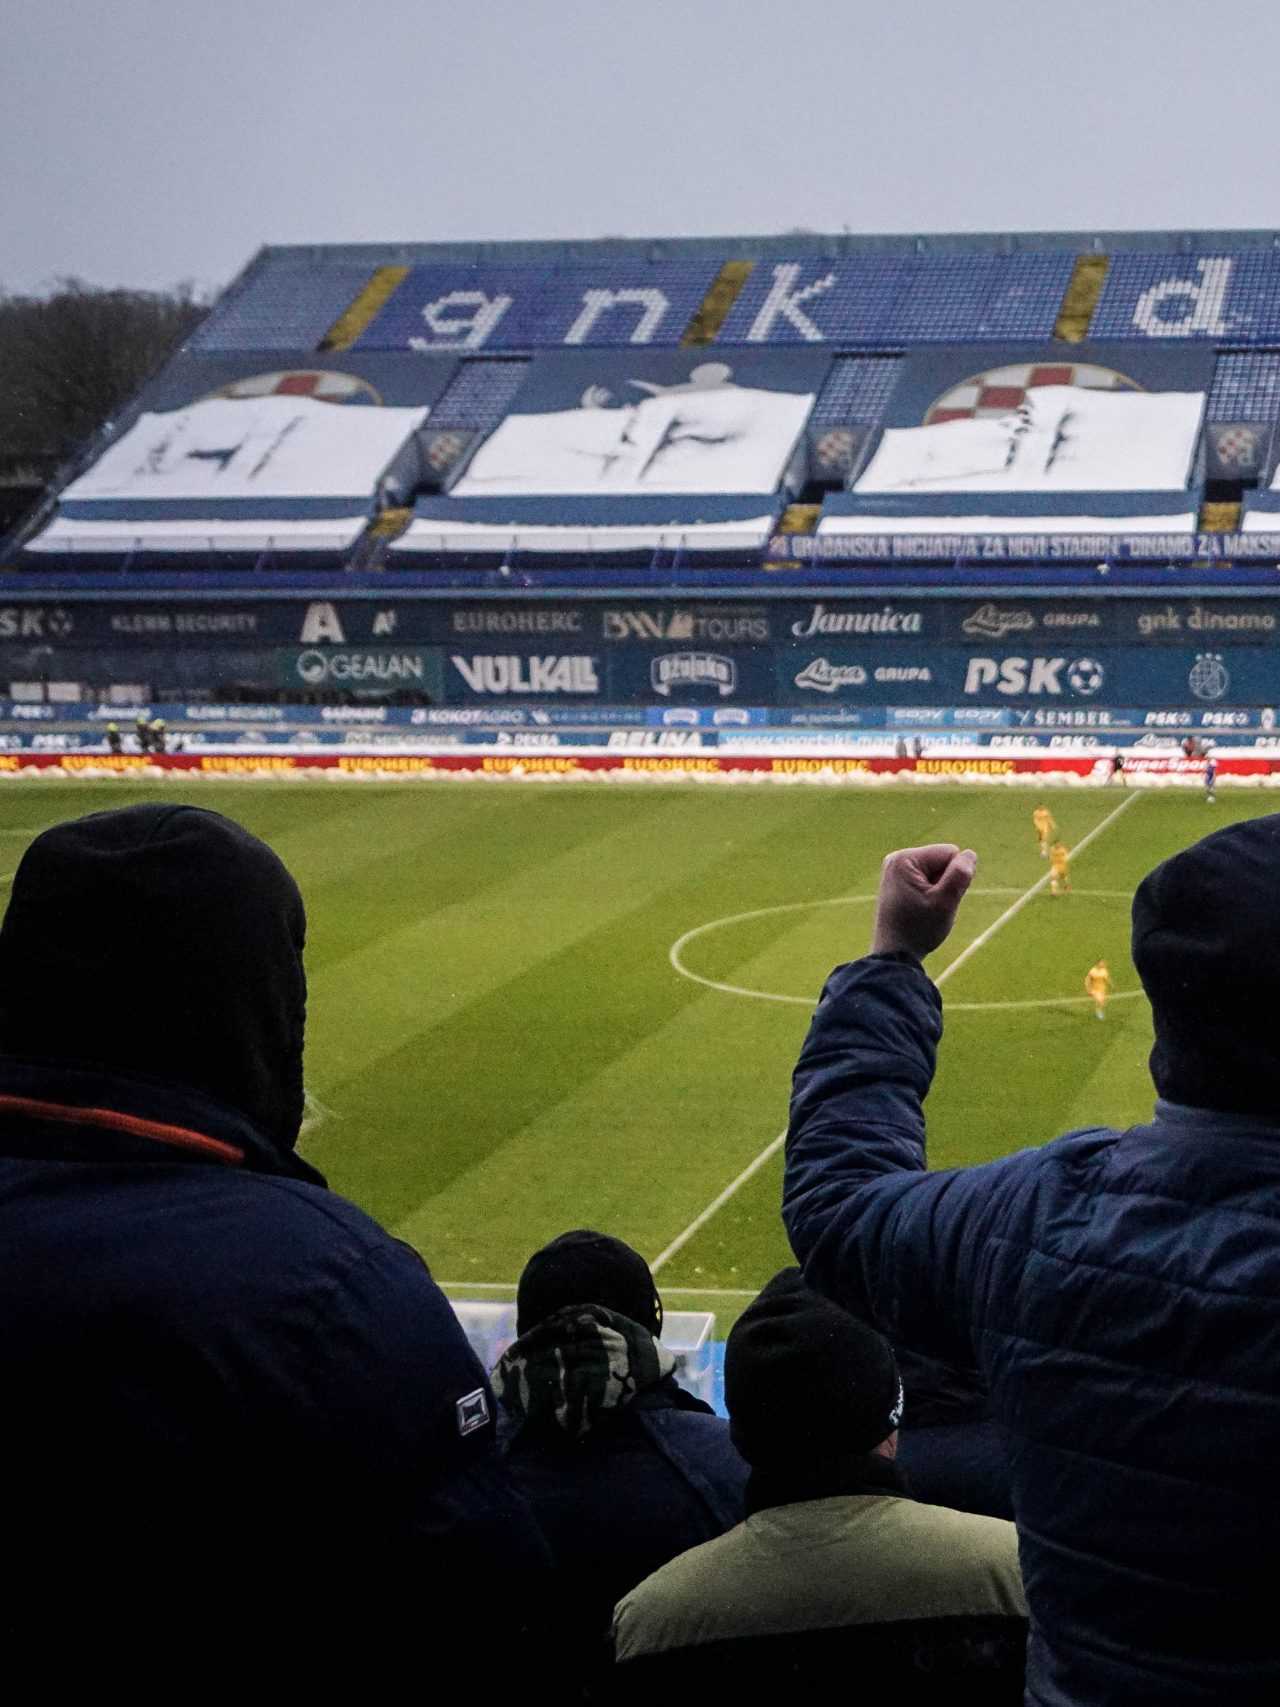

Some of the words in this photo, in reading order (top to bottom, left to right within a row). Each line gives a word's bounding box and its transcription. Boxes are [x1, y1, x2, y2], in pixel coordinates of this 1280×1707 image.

[408, 262, 837, 350] gnk
[1198, 535, 1220, 556] ZA
[453, 610, 583, 633] EUROHERC
[694, 618, 768, 640] TOURS
[792, 604, 922, 638] Jamnica
[1138, 607, 1181, 635] gnk
[1188, 606, 1275, 630] dinamo
[331, 654, 424, 679] GEALAN
[874, 667, 932, 681] GRUPA
[963, 657, 1065, 694] PSK
[1144, 711, 1179, 726] PSK
[1201, 712, 1236, 726] PSK
[607, 730, 701, 747] BELINA
[623, 757, 720, 773] EUROHERC
[915, 759, 1016, 775] EUROHERC
